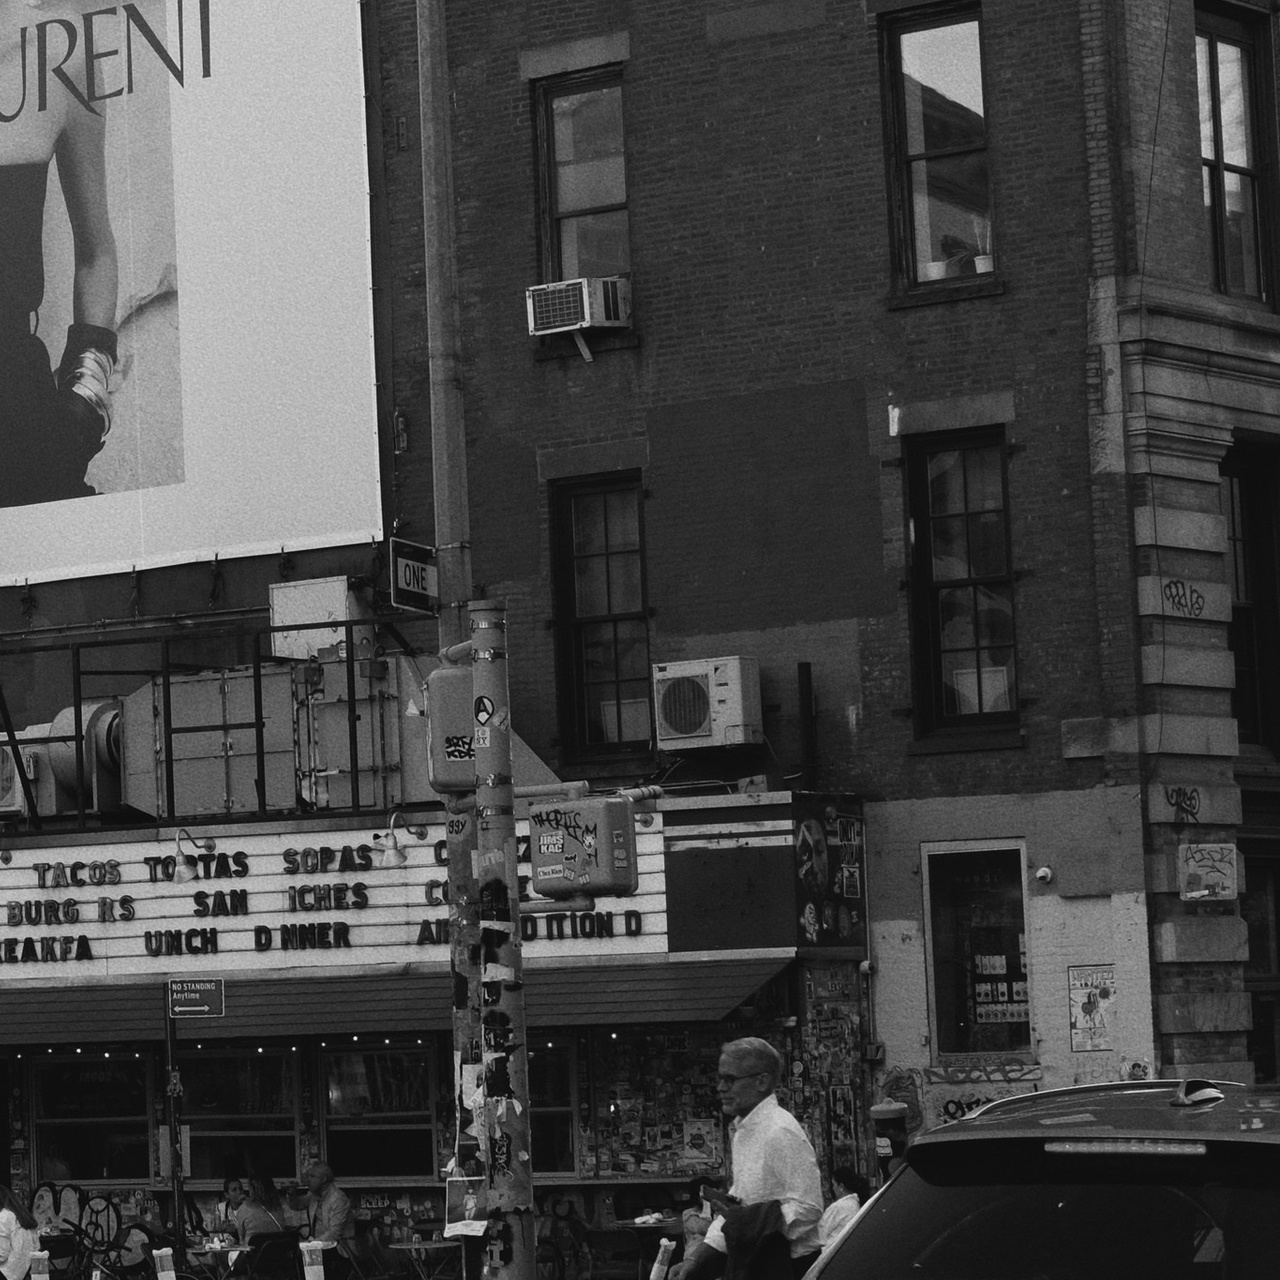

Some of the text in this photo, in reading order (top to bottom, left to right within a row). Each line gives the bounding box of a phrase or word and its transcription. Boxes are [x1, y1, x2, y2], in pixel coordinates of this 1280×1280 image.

[403, 562, 428, 592] ONE
[33, 859, 122, 888] TACOS
[283, 844, 373, 874] SOPAS
[144, 927, 218, 957] UNCH
[172, 982, 216, 991] NO STANDING
[173, 992, 200, 1000] Anytime
